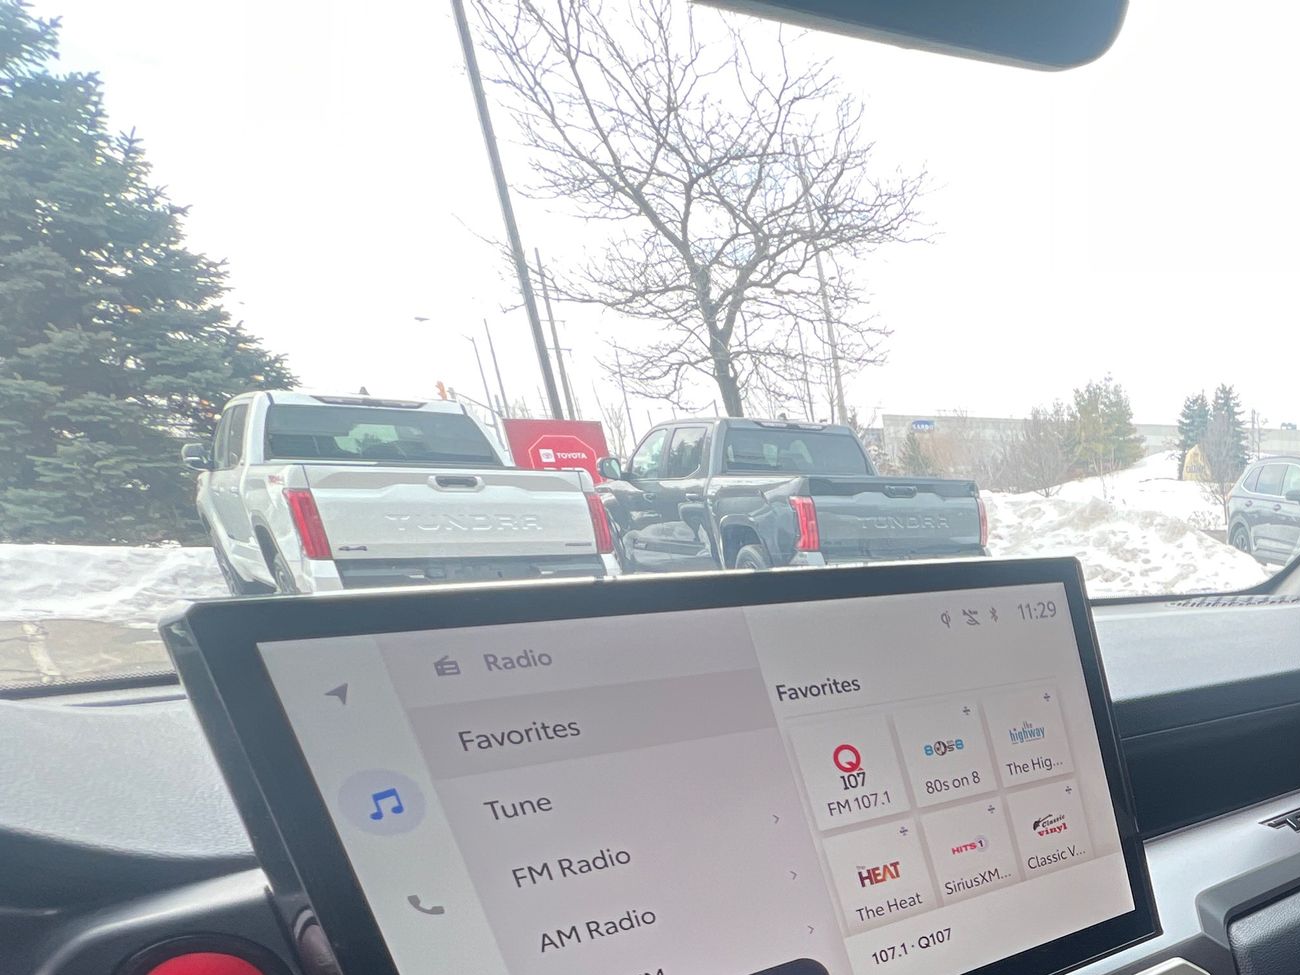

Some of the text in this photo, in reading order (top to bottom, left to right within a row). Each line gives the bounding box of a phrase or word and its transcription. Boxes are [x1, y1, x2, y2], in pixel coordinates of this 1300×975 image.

[384, 513, 543, 531] TUNDRA
[856, 515, 950, 529] TUNDRA
[1017, 601, 1057, 621] 11:29
[483, 649, 553, 673] Radio
[776, 676, 862, 703] Favorites
[458, 720, 581, 752] Favorites
[1009, 726, 1046, 743] highway
[833, 744, 865, 773] Q
[1006, 763, 1030, 777] The
[840, 772, 866, 790] 107
[925, 771, 981, 795] 80s on 8
[483, 796, 553, 821] Tune
[828, 791, 892, 817] FM 107.1
[1037, 823, 1068, 837] vinyl
[1042, 814, 1066, 828] Classic
[951, 842, 977, 855] HITS
[1028, 849, 1067, 870] Classic
[512, 849, 631, 888] FM Radio
[858, 861, 901, 888] HEAT
[856, 892, 923, 922] The Heat
[540, 908, 656, 953] AM Radio
[872, 928, 952, 965] 107.1 Q107
